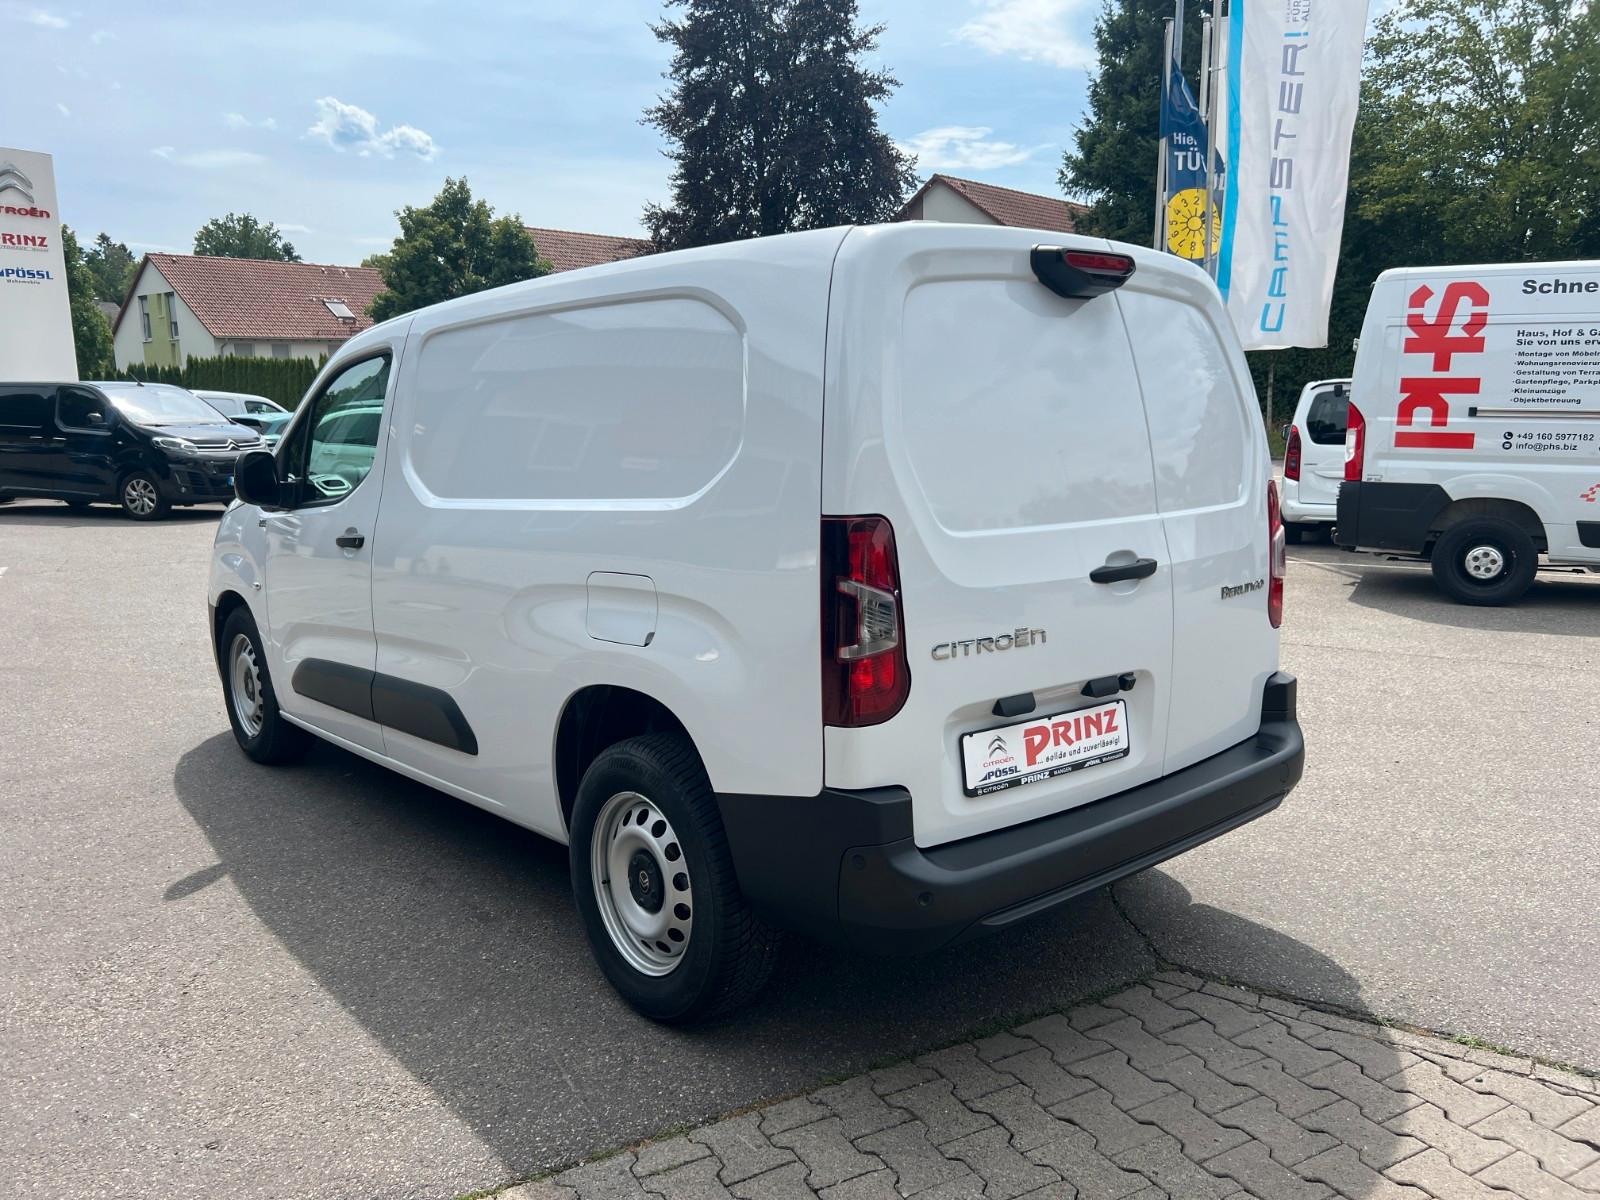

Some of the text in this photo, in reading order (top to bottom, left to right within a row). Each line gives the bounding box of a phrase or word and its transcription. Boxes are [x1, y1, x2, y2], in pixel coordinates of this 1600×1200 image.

[1301, 0, 1311, 21] ALL
[5, 266, 54, 280] PÖSSL
[1522, 278, 1599, 295] Schne
[1516, 329, 1549, 338] Haus,
[1552, 328, 1573, 337] Hof
[1576, 328, 1585, 337] &
[1516, 338, 1534, 346] Sie
[1516, 432, 1595, 441] +49 160 5977182
[1515, 442, 1578, 452] info@phs.biz
[1023, 708, 1119, 767] PRINZ
[1045, 751, 1067, 763] solide
[1068, 746, 1081, 757] und
[986, 765, 1022, 780] PÖSSL
[1021, 771, 1050, 785] PRINZ
